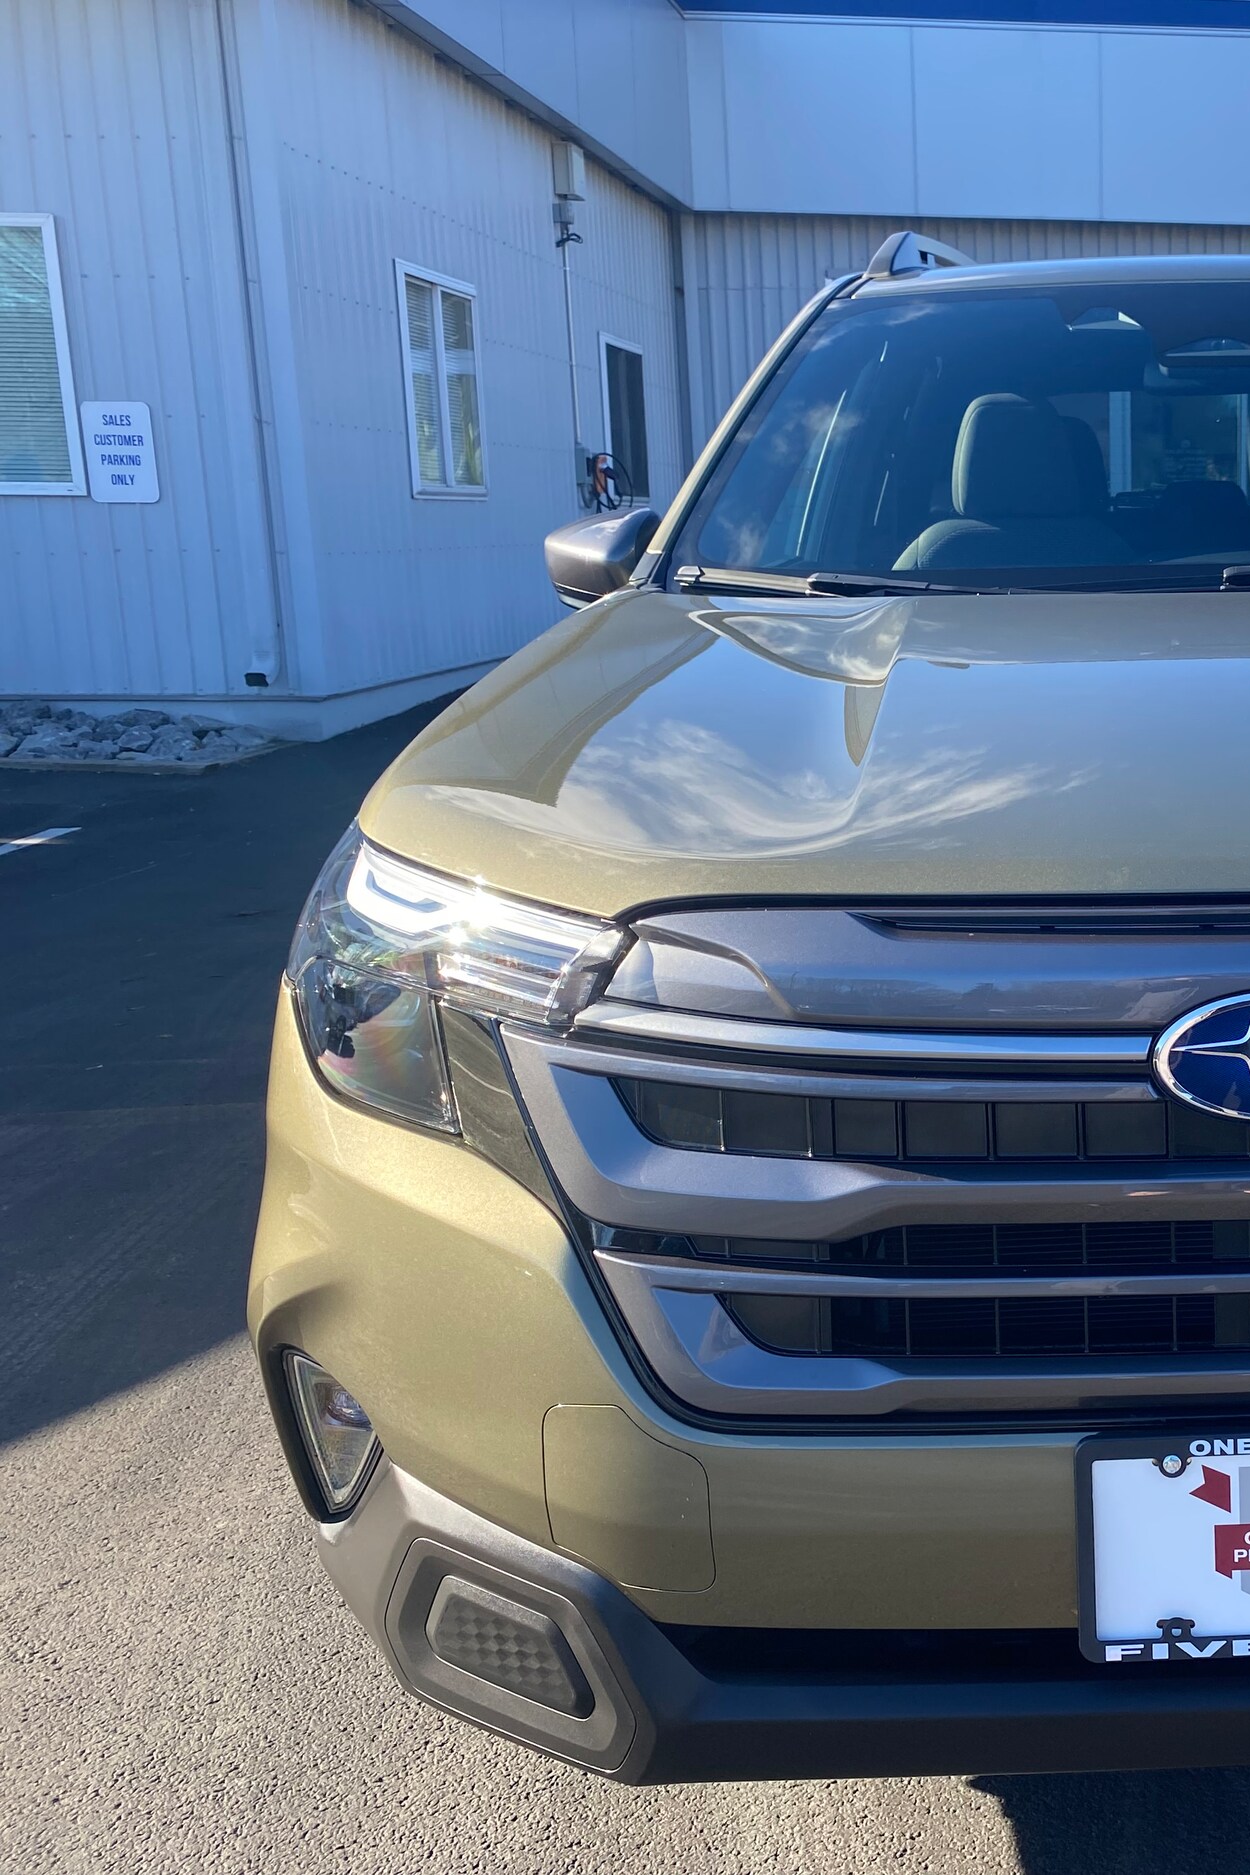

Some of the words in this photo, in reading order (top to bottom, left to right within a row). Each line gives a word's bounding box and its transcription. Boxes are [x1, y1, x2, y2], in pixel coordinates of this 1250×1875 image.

[102, 414, 131, 426] SALES
[94, 434, 144, 446] CUSTOMER
[101, 454, 141, 466] PARKING
[111, 474, 135, 485] ONLY
